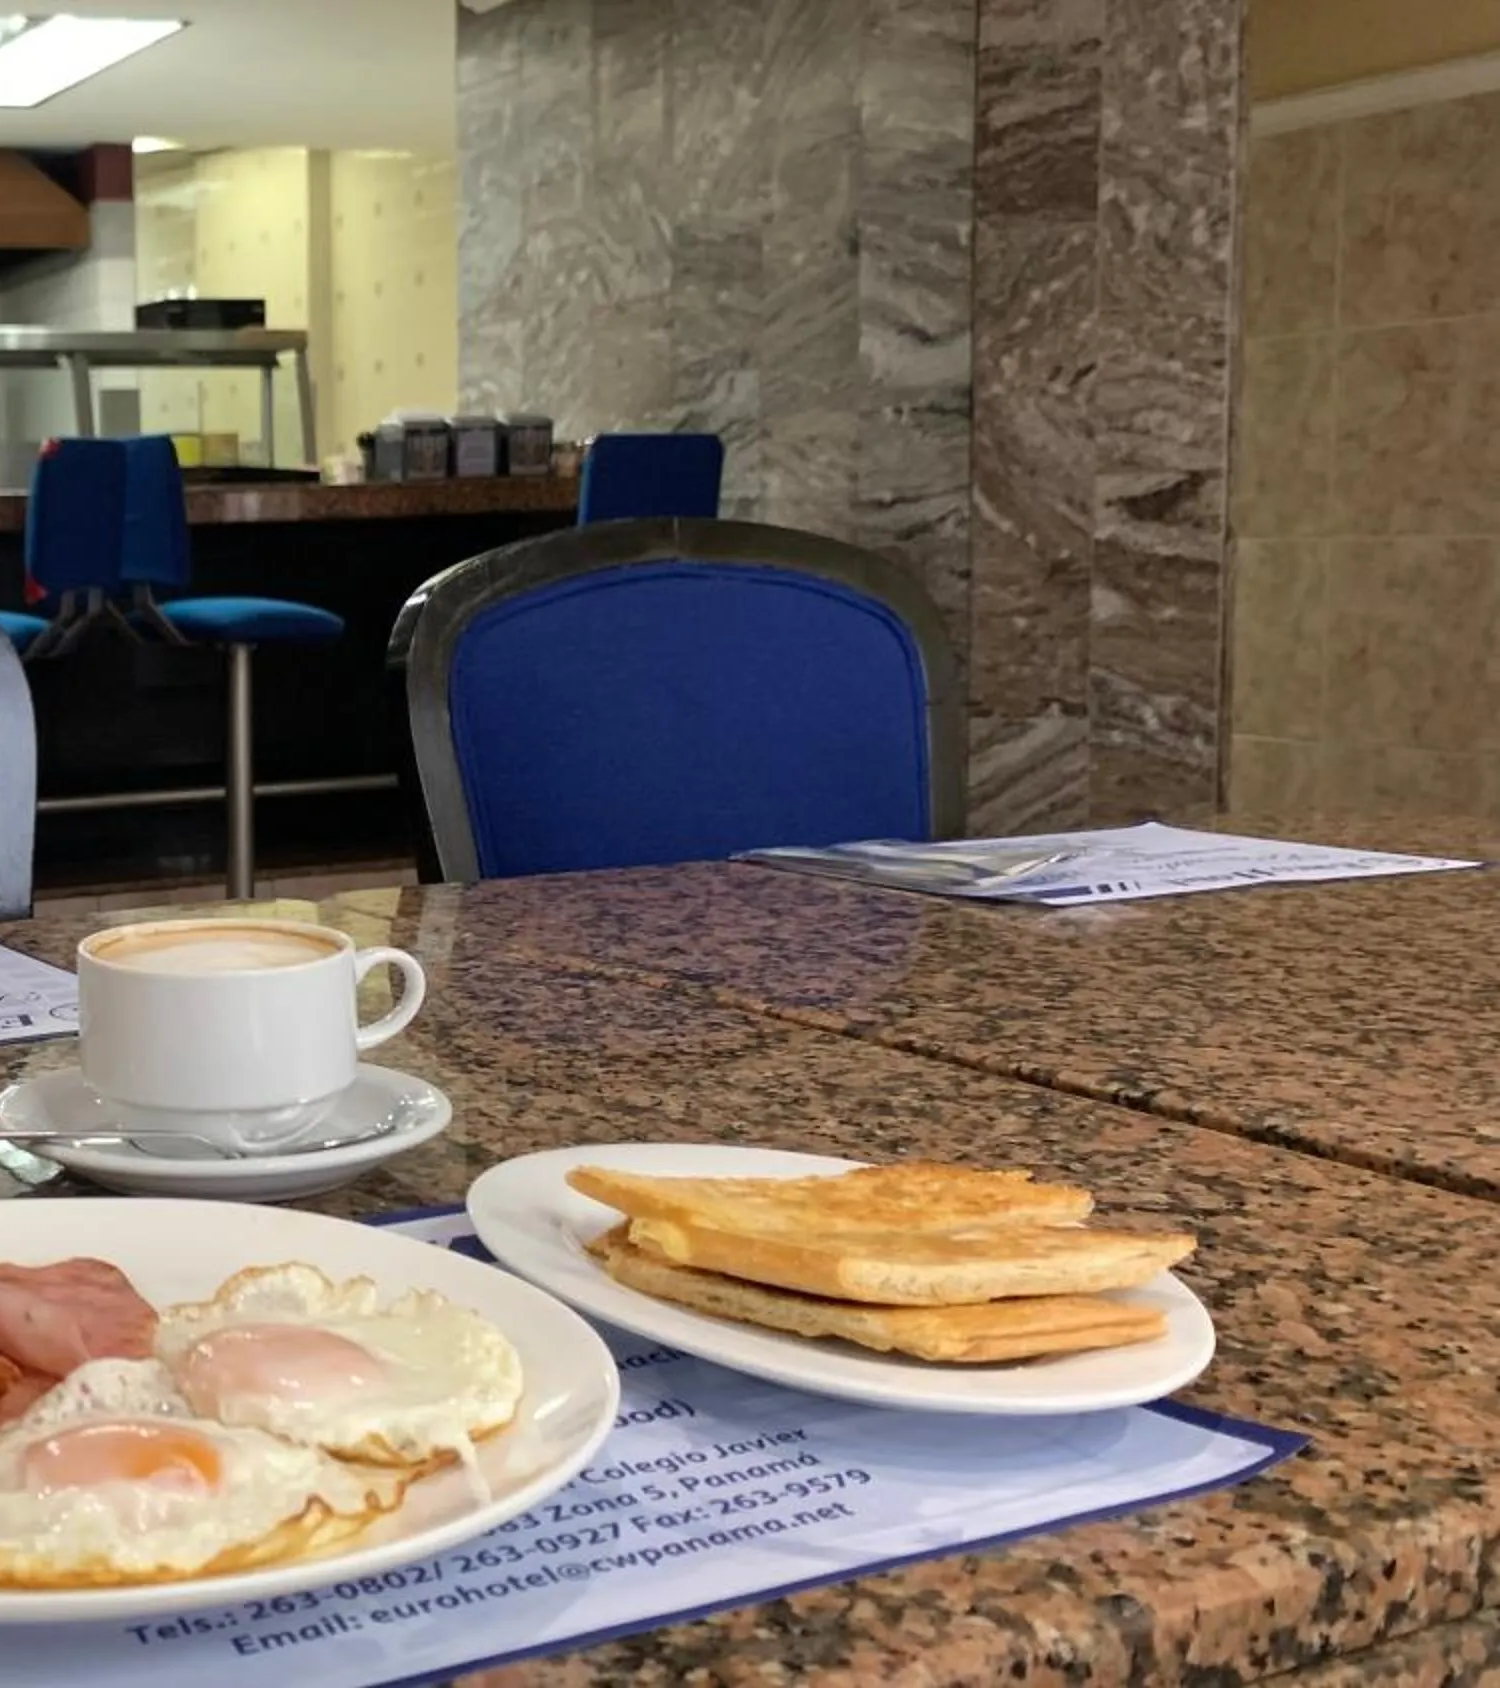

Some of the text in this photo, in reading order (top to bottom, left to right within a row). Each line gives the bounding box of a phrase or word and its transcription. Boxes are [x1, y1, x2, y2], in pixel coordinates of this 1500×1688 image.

[544, 1493, 638, 1522] Zona
[641, 1485, 679, 1501] 5,
[678, 1451, 821, 1492] Panamá
[579, 1427, 809, 1484] Colegio Javier
[127, 1468, 872, 1645] Tels.: 263-0802/ 263-0927 Fax: 263-9579
[231, 1500, 855, 1655] Email: eurohotel@cwpanama.net
